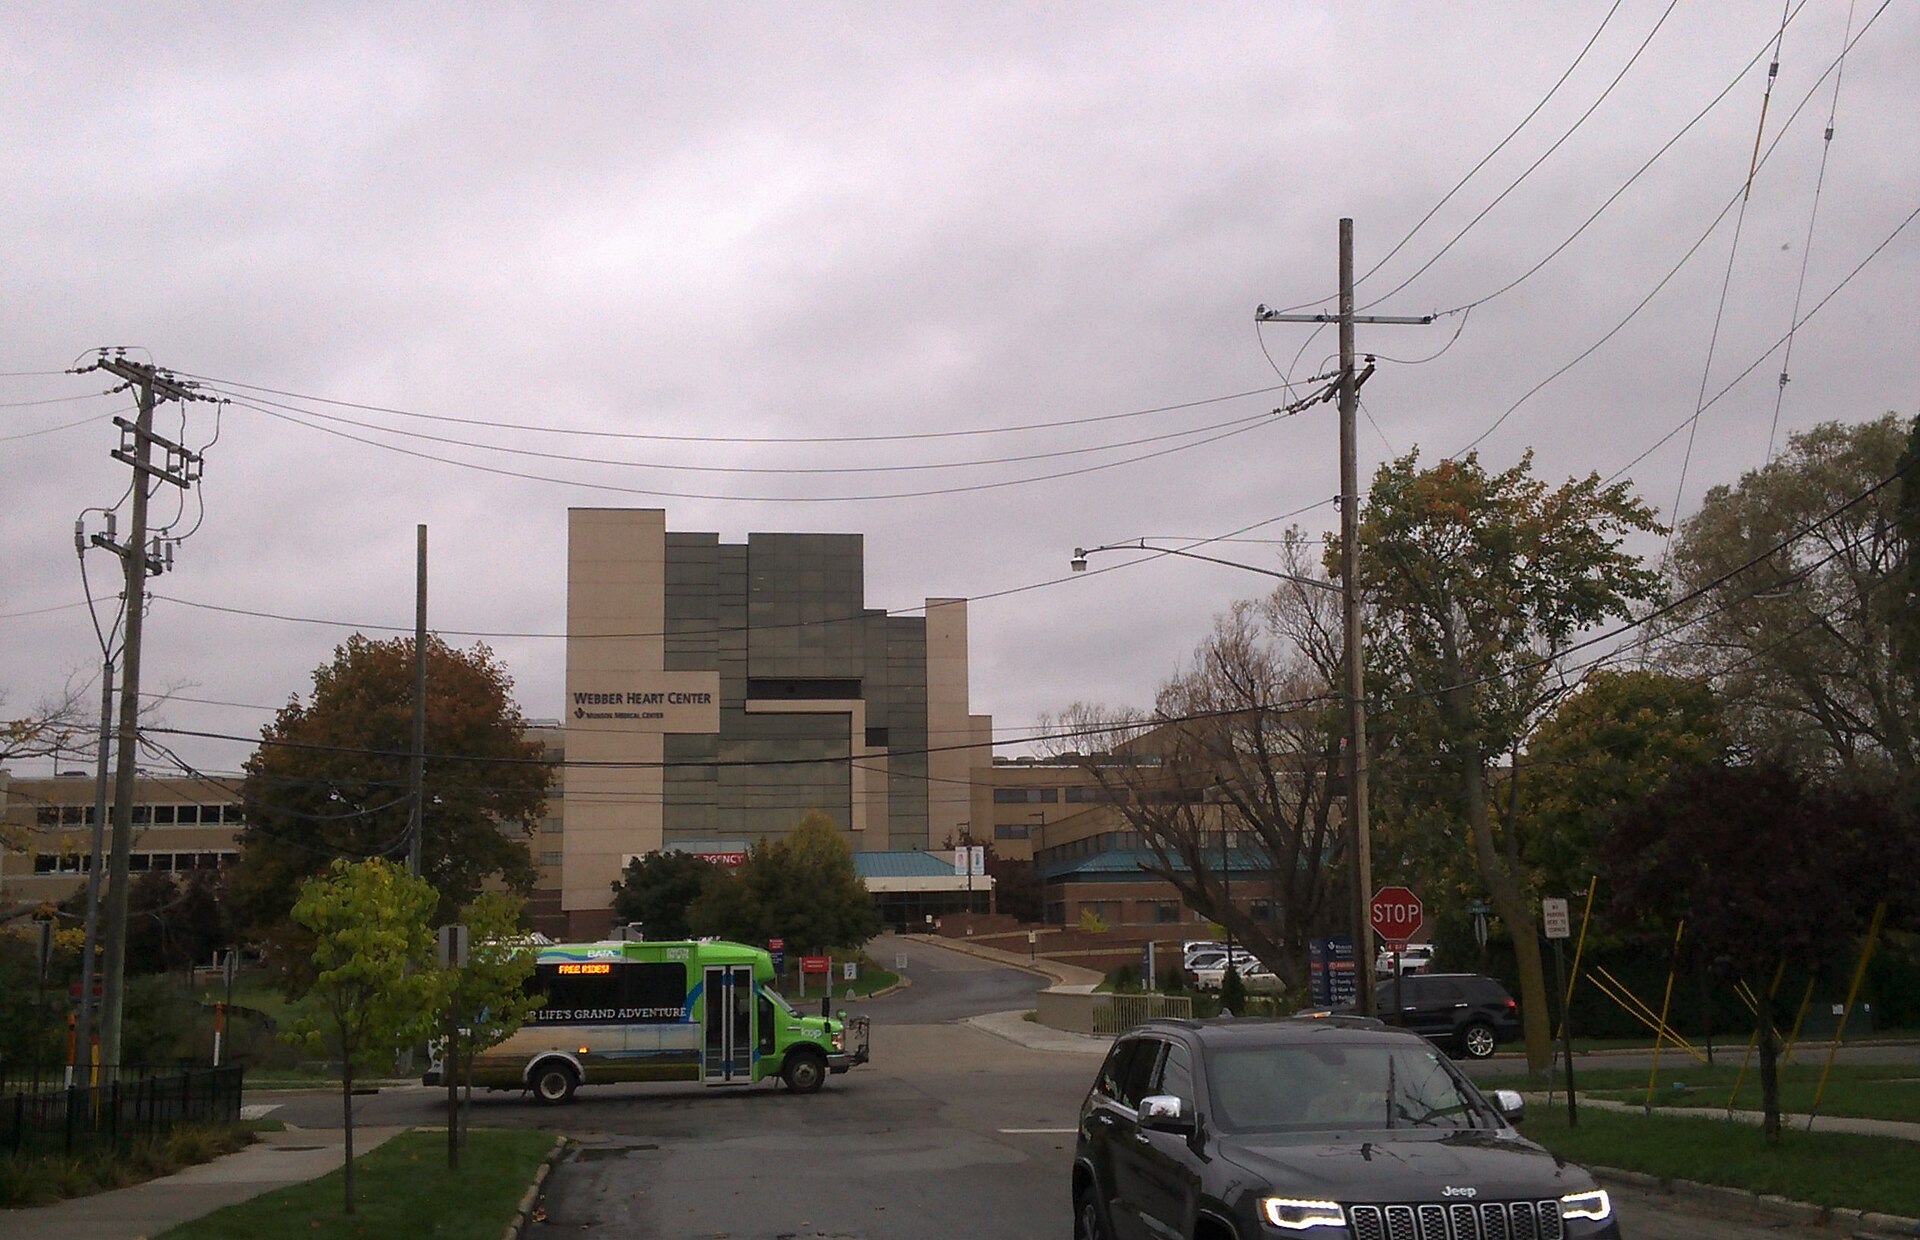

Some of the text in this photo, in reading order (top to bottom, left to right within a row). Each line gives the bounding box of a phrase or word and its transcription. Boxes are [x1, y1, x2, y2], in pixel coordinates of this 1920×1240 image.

[573, 692, 711, 704] WEBBER HEART CENTER
[641, 711, 664, 719] CENTER
[1373, 903, 1419, 923] STOP
[559, 964, 581, 974] FREE
[539, 1009, 571, 1020] LIFE'S
[574, 1008, 615, 1019] GRAND
[618, 1007, 687, 1018] ADVENTURE
[1441, 1185, 1477, 1198] Jeep
